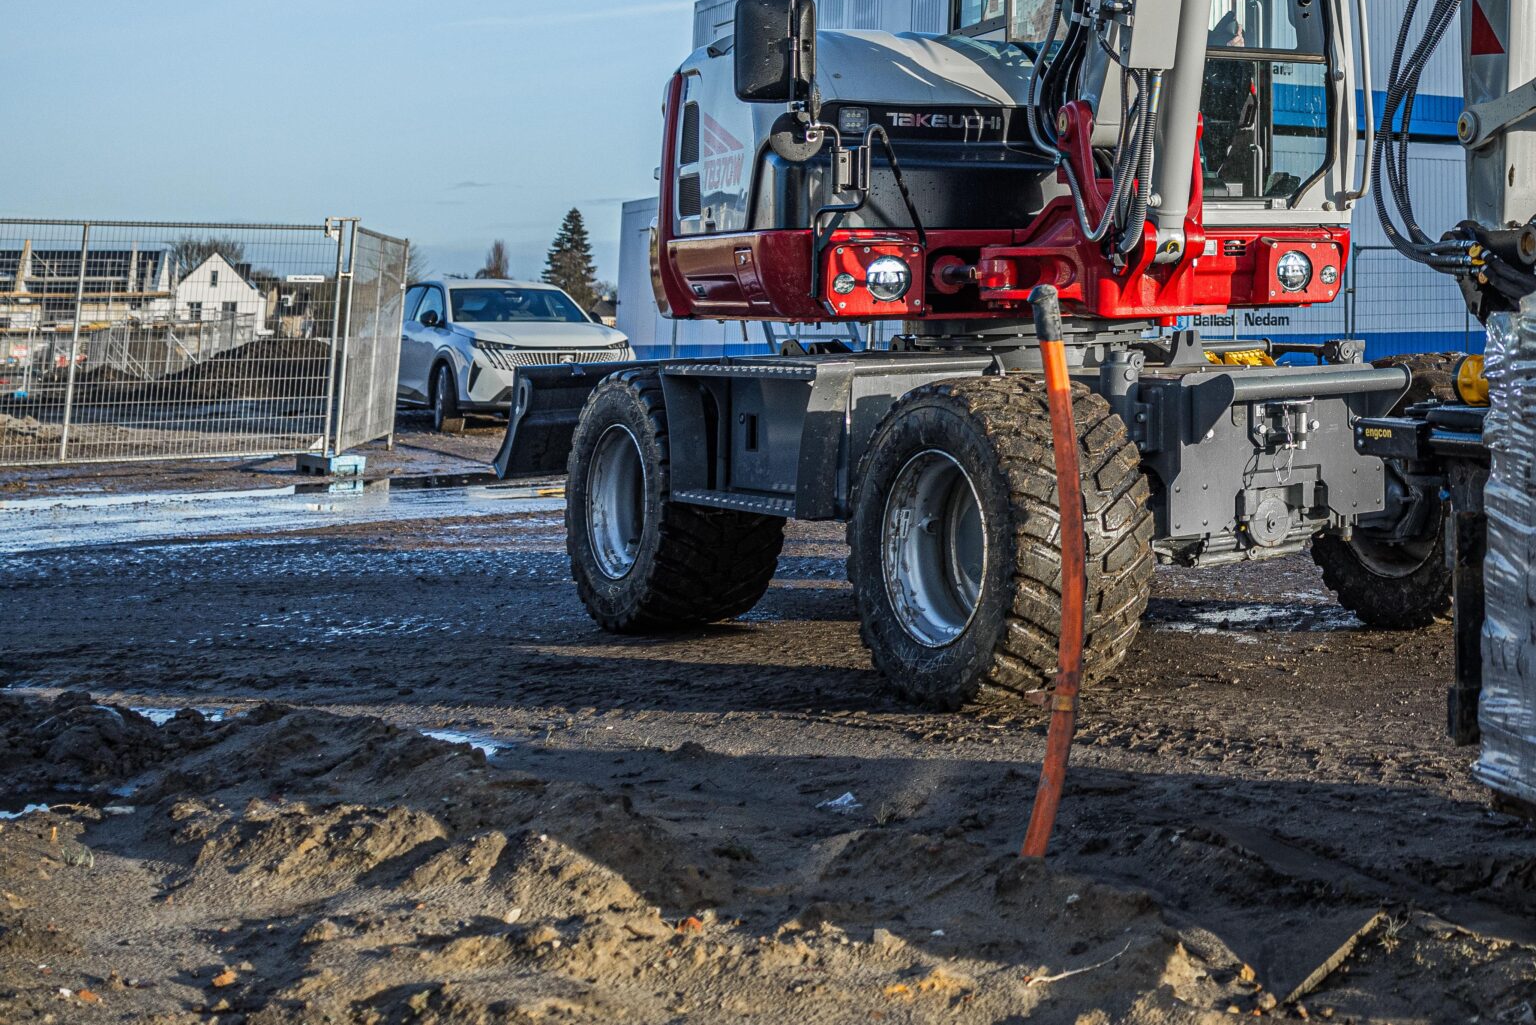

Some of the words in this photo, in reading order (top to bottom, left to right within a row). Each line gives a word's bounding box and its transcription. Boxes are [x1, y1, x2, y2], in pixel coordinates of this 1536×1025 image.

[1193, 314, 1237, 327] Ballast
[1244, 313, 1290, 327] Nedam
[1365, 428, 1392, 440] engcon
